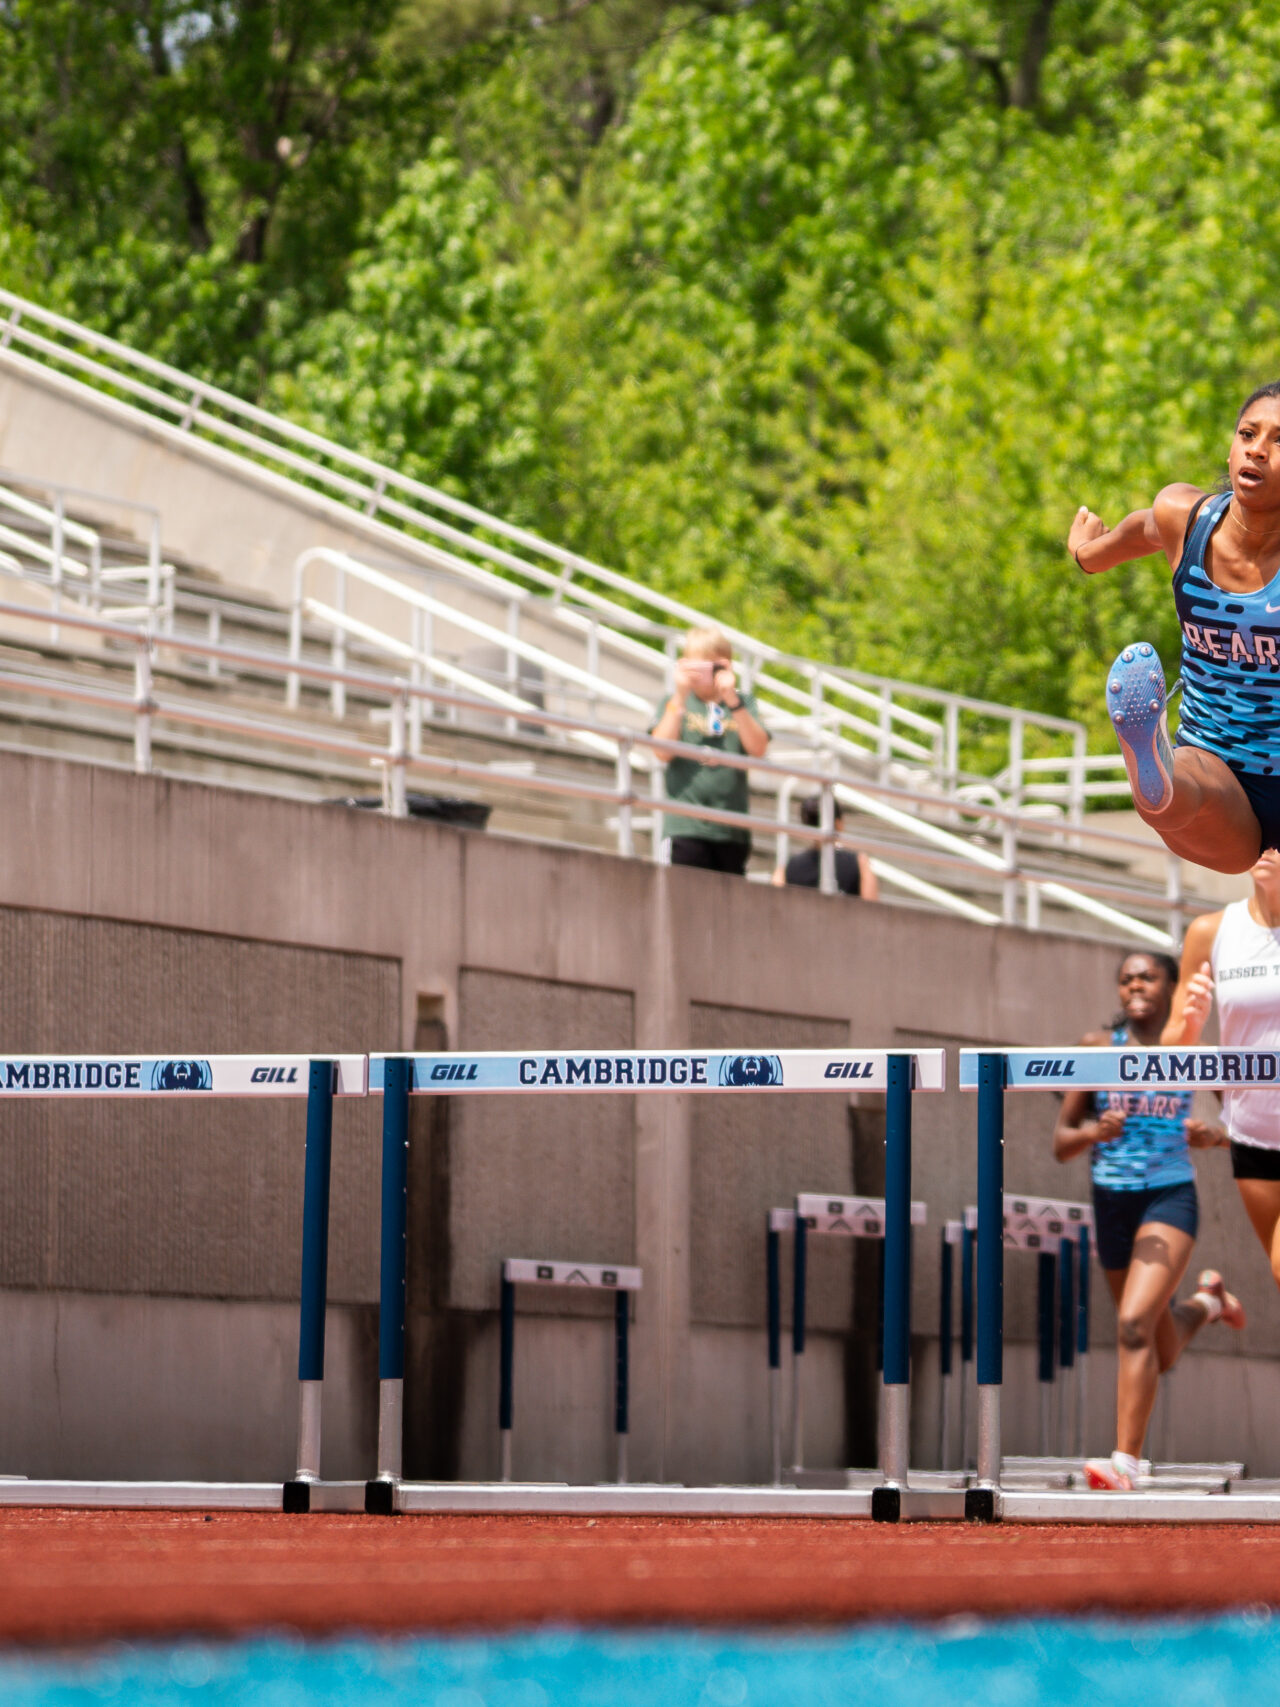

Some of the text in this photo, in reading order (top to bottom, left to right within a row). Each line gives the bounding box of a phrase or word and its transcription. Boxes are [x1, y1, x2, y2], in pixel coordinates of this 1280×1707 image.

[0, 1063, 297, 1089] MBRIDGE GILL
[430, 1058, 873, 1085] GILL CAMBRIDGE GILL
[1024, 1060, 1075, 1077] GILL
[1107, 1092, 1182, 1119] BEARS
